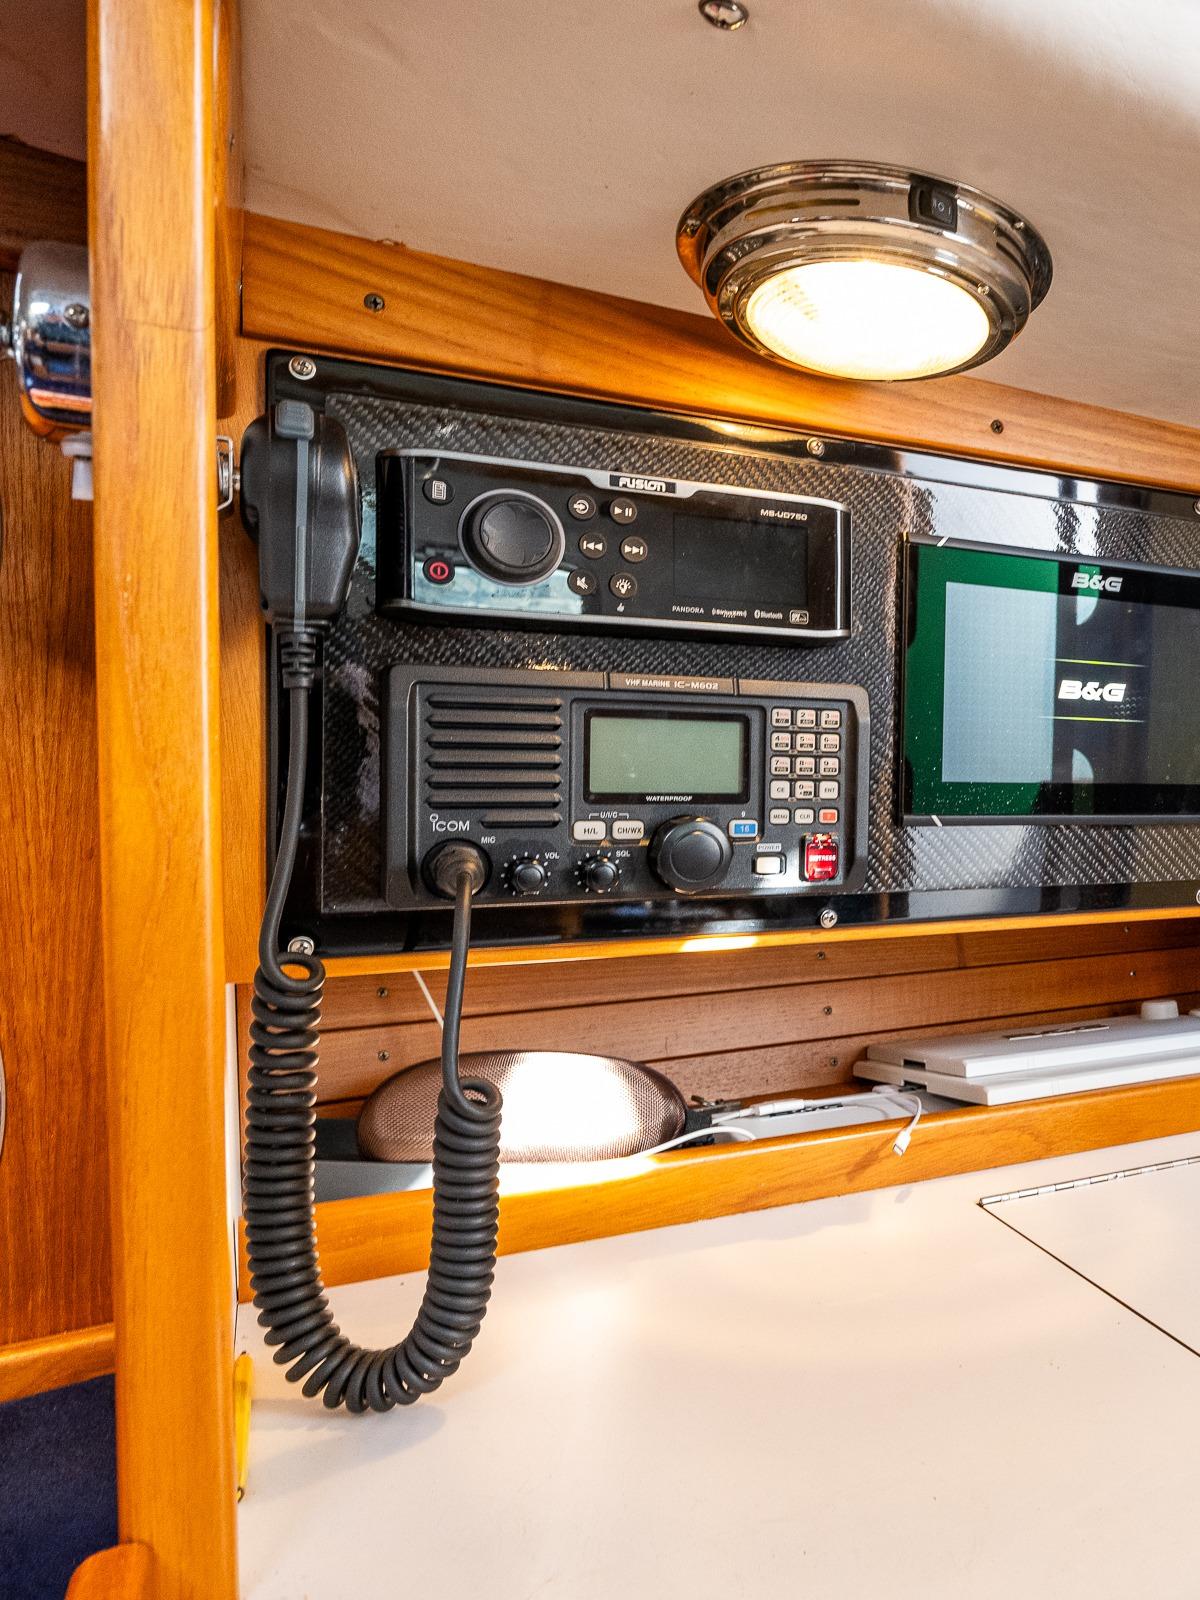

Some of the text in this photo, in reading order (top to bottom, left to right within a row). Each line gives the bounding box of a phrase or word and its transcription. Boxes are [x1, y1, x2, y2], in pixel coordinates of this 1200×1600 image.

[619, 476, 666, 493] FUSION
[1071, 572, 1123, 593] B&G
[672, 605, 704, 614] PANDORA
[625, 678, 718, 690] VHF MARINE IC-M602
[1058, 680, 1127, 702] B&G
[481, 836, 496, 844] MIC
[545, 852, 559, 860] VOL
